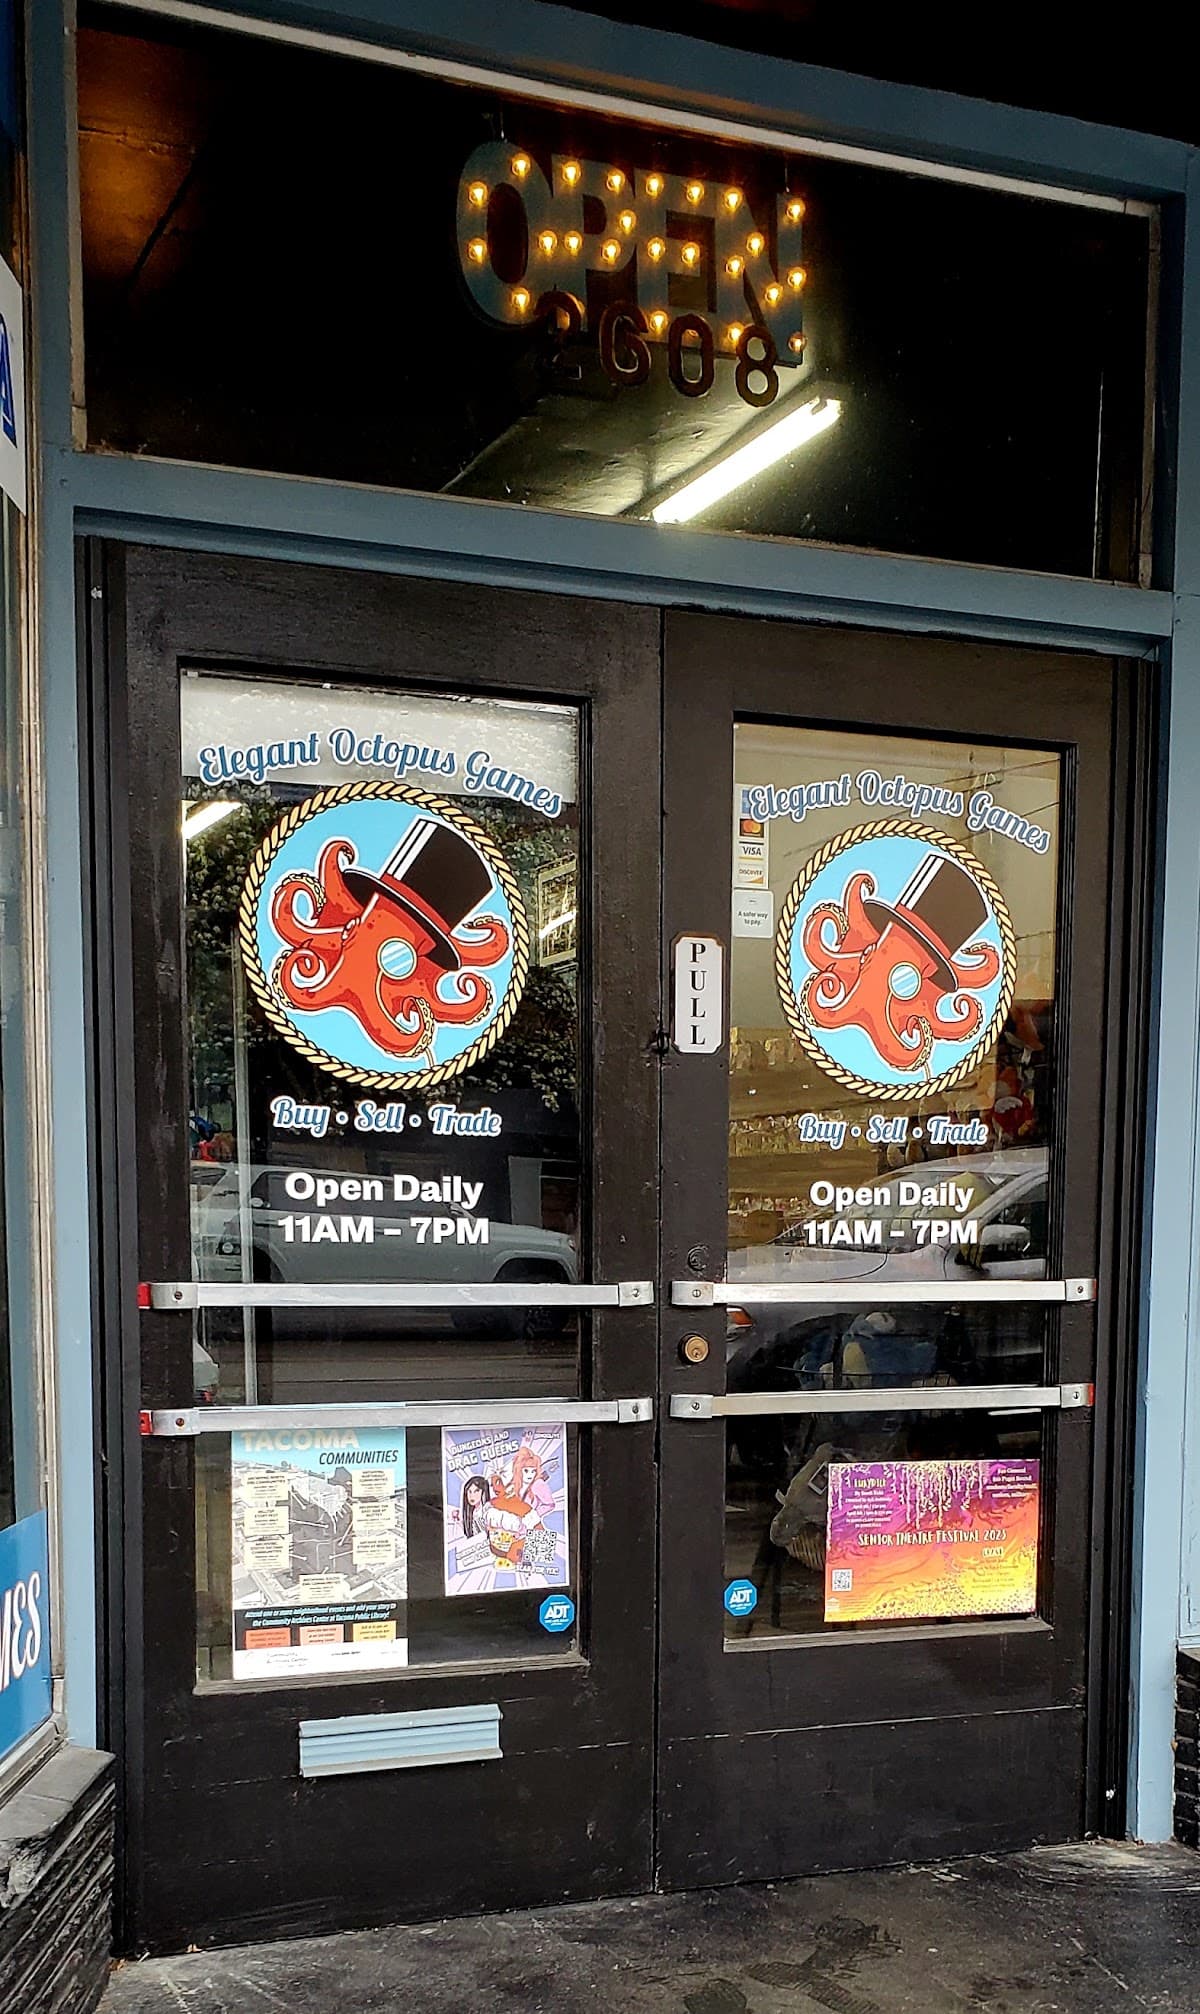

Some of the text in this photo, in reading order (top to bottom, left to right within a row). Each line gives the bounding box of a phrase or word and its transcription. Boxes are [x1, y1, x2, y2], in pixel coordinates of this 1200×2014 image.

[456, 140, 804, 368] OPEN
[536, 290, 779, 407] 2608
[199, 727, 562, 818] Elegant Octopus Games
[749, 770, 1050, 854] Elegant Octopus Games
[742, 846, 762, 856] VISA
[689, 942, 707, 1046] PULL
[271, 1095, 501, 1137] Buy Sell Trade
[799, 1112, 988, 1149] Buy Sell Trade
[285, 1171, 484, 1210] Open Daily
[809, 1180, 975, 1213] Open Daily
[278, 1215, 375, 1243] 11AM
[410, 1217, 490, 1245] 7PM
[803, 1219, 882, 1245] 11AM
[912, 1220, 978, 1245] 7PM
[240, 1428, 360, 1451] TACOMA
[450, 1430, 510, 1456] DUNGEONS AND
[319, 1450, 399, 1465] COMMUNITIES
[448, 1440, 520, 1472] DRAG QUEENS
[858, 1533, 893, 1546] SENIOR
[896, 1530, 933, 1545] THEATRE
[936, 1528, 980, 1543] FESTIVAL
[544, 1604, 570, 1619] ADT
[729, 1589, 752, 1604] ADT
